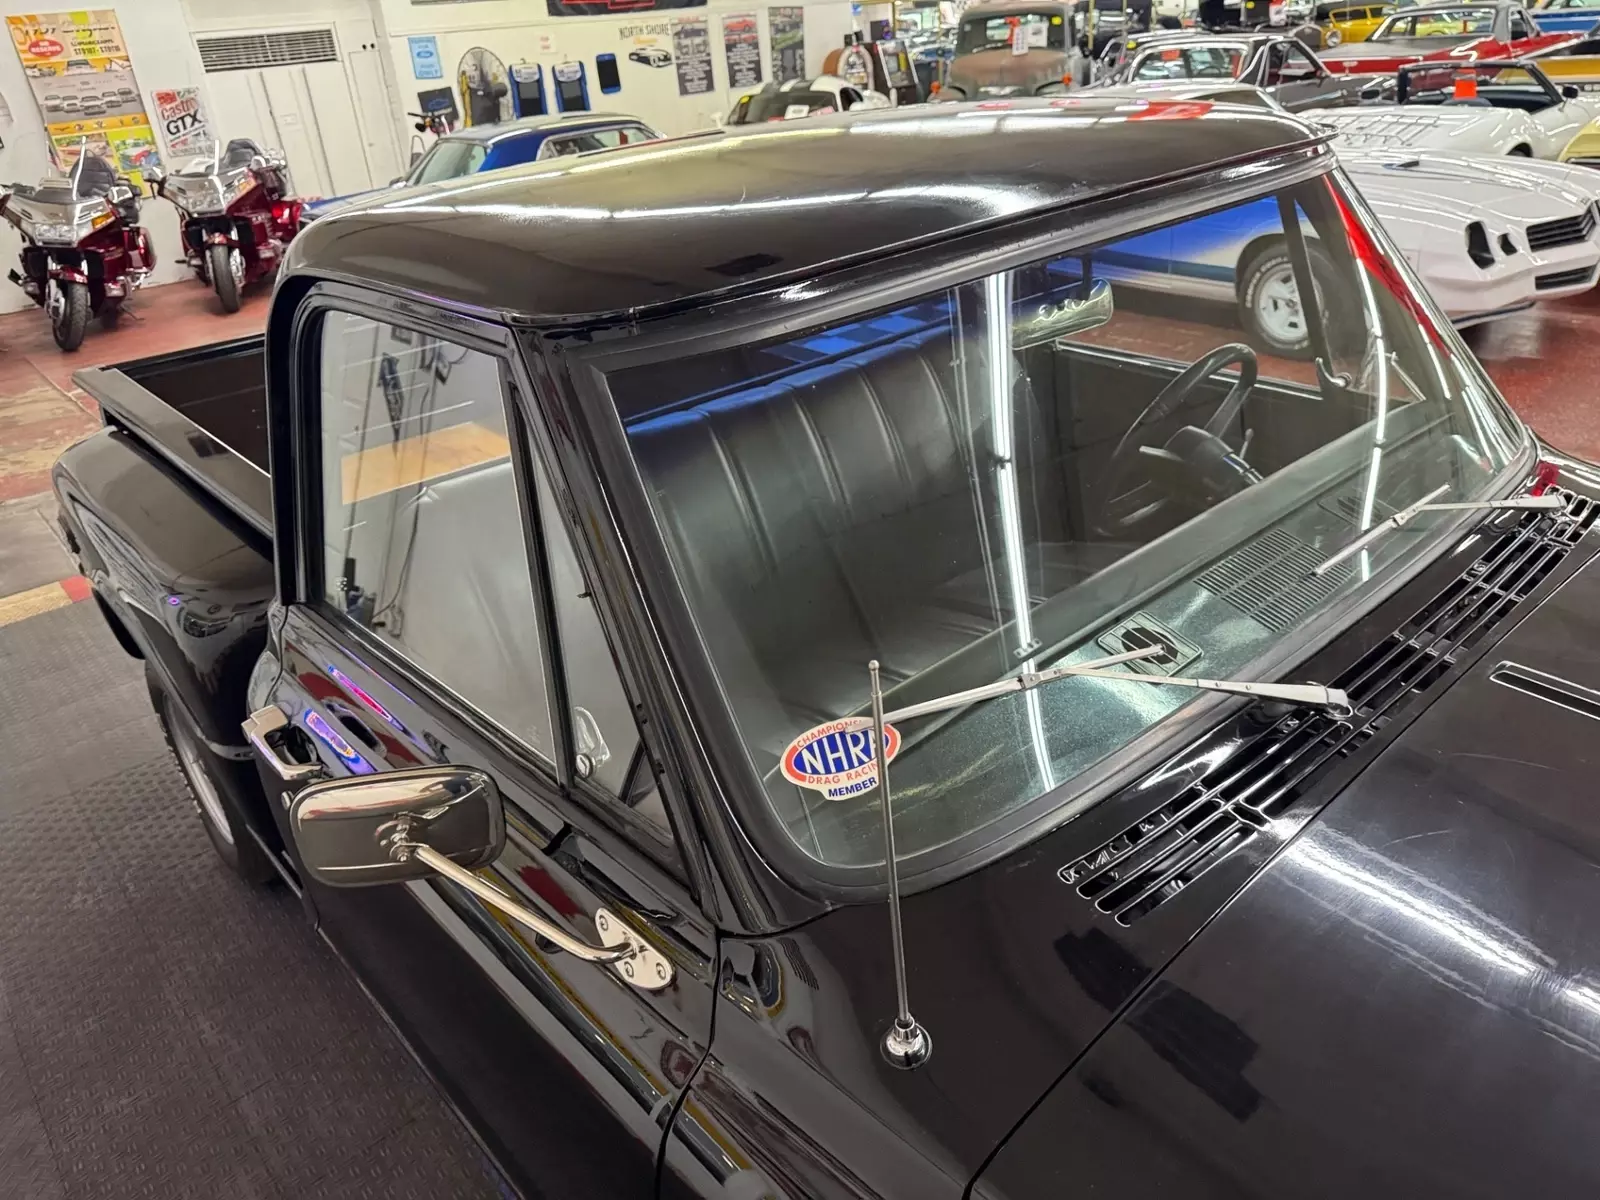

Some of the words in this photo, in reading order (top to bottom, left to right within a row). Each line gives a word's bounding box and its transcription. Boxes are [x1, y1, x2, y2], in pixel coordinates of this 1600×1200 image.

[618, 25, 644, 40] NORTH
[645, 23, 670, 37] SHORE
[166, 108, 203, 136] GTX
[807, 774, 841, 785] DRAG
[846, 762, 878, 781] RACIN
[828, 776, 878, 798] MEMBER
